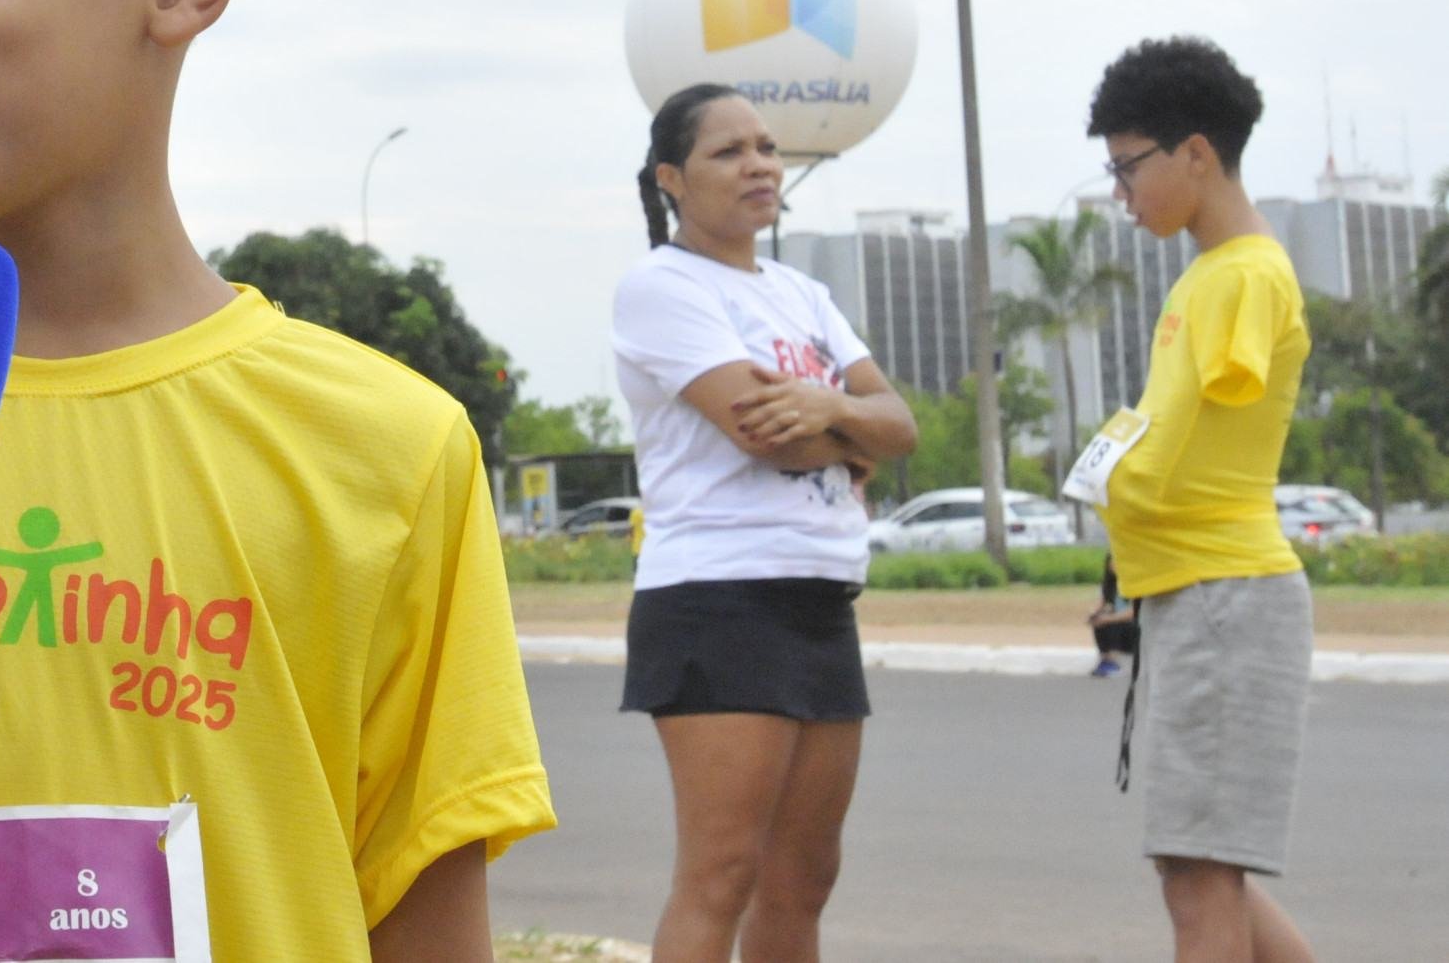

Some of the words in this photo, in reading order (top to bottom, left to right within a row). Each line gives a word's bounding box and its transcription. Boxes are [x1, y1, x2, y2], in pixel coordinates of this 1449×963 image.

[110, 661, 237, 731] 2025
[77, 868, 99, 897] 8
[49, 905, 129, 931] anos
